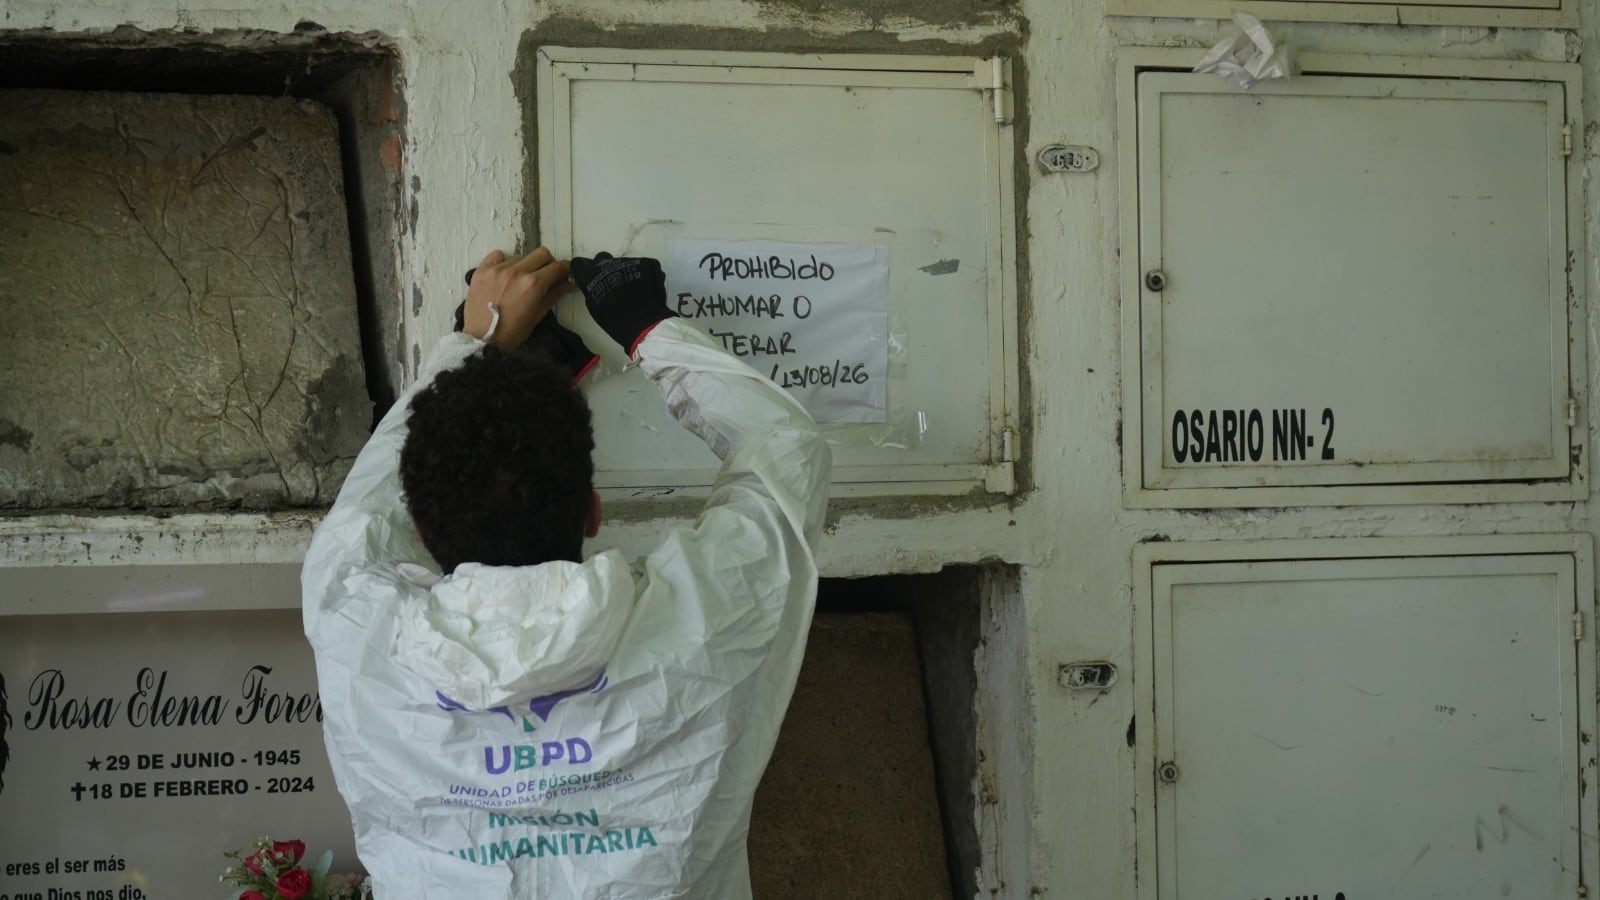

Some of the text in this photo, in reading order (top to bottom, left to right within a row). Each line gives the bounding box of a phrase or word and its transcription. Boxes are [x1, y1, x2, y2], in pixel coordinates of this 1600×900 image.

[678, 293, 811, 319] EXHUMAR O
[709, 329, 796, 357] TERAR
[1172, 409, 1264, 463] OSARIO
[1321, 408, 1335, 461] 2
[24, 669, 121, 731] Rosa
[127, 667, 230, 728] Elena
[106, 755, 130, 771] 29
[137, 754, 164, 770] DE
[171, 751, 235, 769] JUNIO
[254, 749, 301, 766] 1945
[484, 737, 593, 775] UBPD
[89, 783, 113, 800] 18
[120, 782, 146, 798] DE
[153, 778, 249, 797] FEBRERO
[267, 776, 315, 793] 2024
[450, 784, 512, 798] UNIDAD
[516, 780, 535, 793] DE
[448, 826, 658, 866] UMANITARIA
[6, 854, 125, 876] eres el ser más
